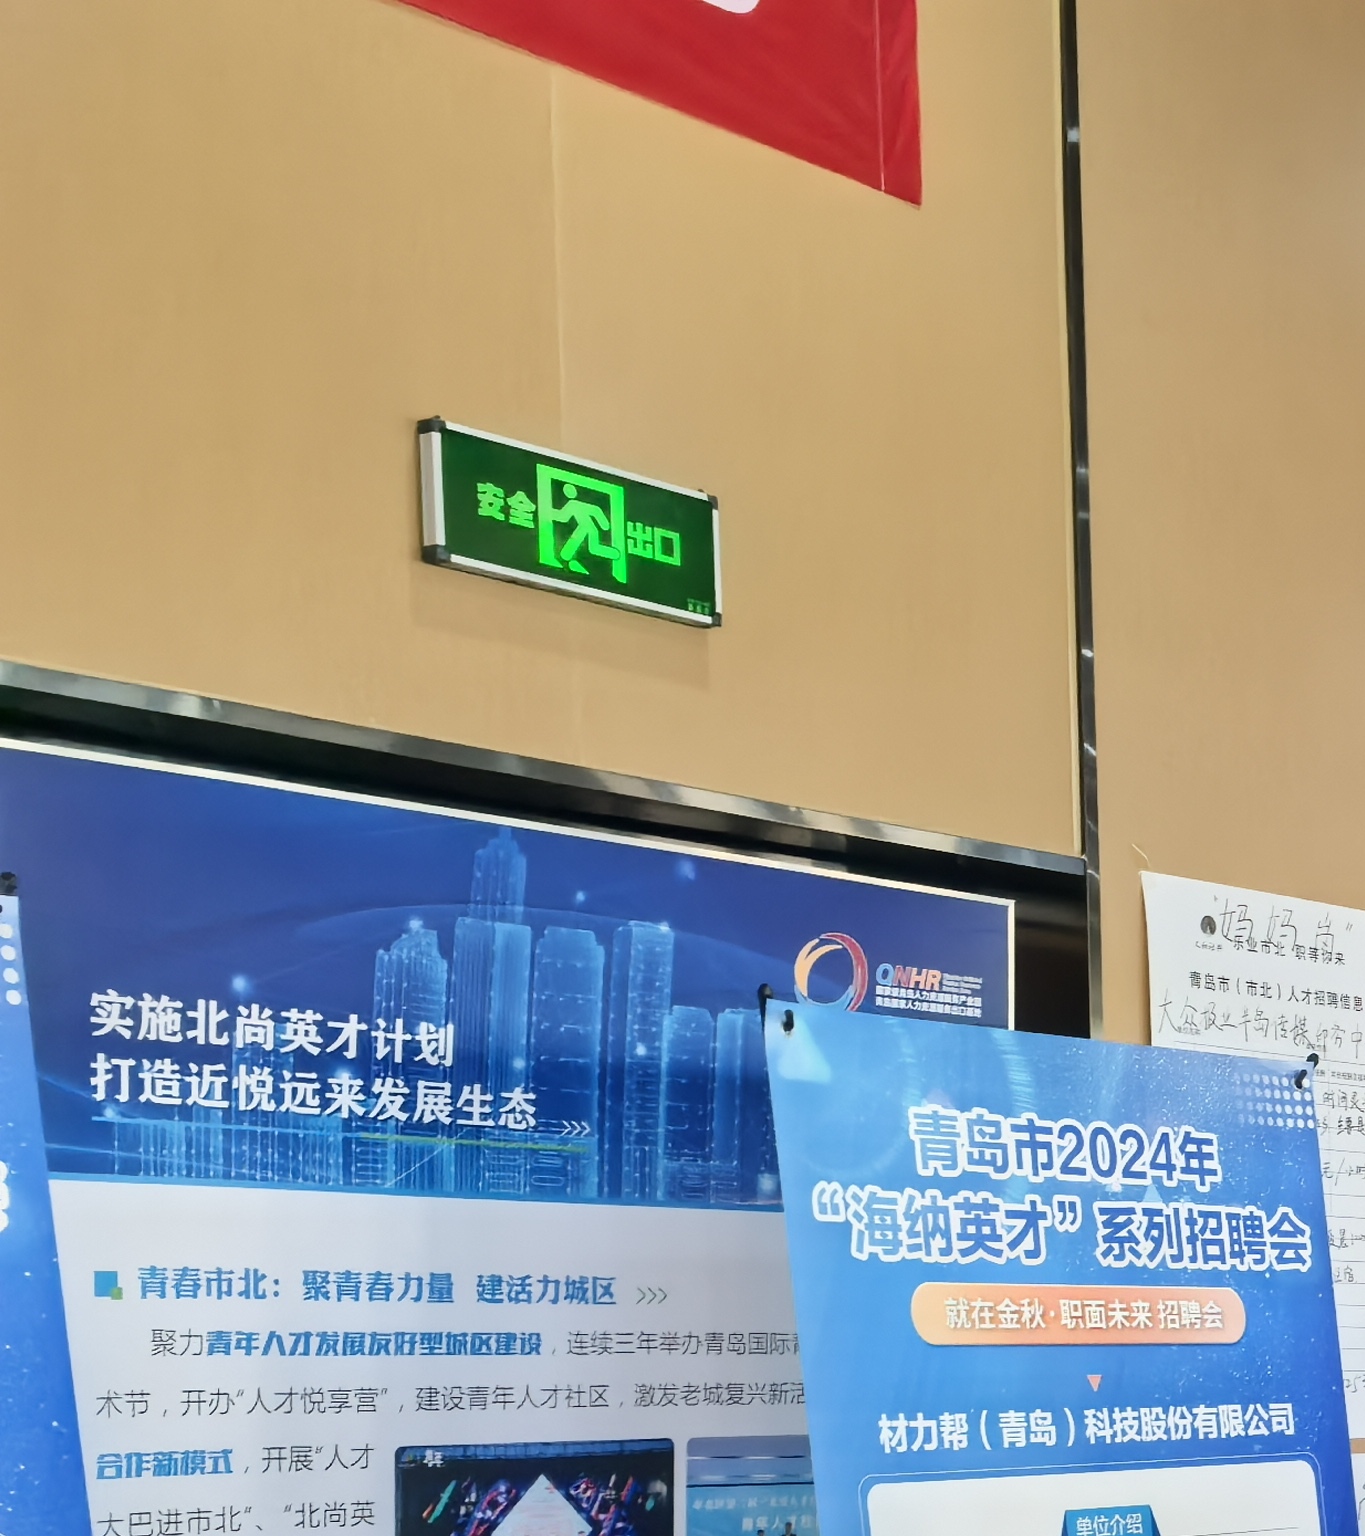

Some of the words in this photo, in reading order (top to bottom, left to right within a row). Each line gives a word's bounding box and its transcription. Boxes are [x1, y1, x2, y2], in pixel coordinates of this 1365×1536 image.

[476, 481, 536, 530] 安全
[627, 520, 681, 567] 出口
[875, 962, 942, 991] QNHR
[1188, 970, 1364, 1012] 青岛市（市北）人才招聘信息
[90, 988, 455, 1067] 实施北尚英才计划
[90, 1052, 538, 1131] 打造近悦远来发展生态
[907, 1104, 1222, 1192] 青岛市2024年
[811, 1180, 1312, 1272] “海纳英才”系列招聘会
[476, 1274, 617, 1306] 建活力城区
[877, 1402, 1296, 1454] 材力帮（青岛）科技股份有限公司
